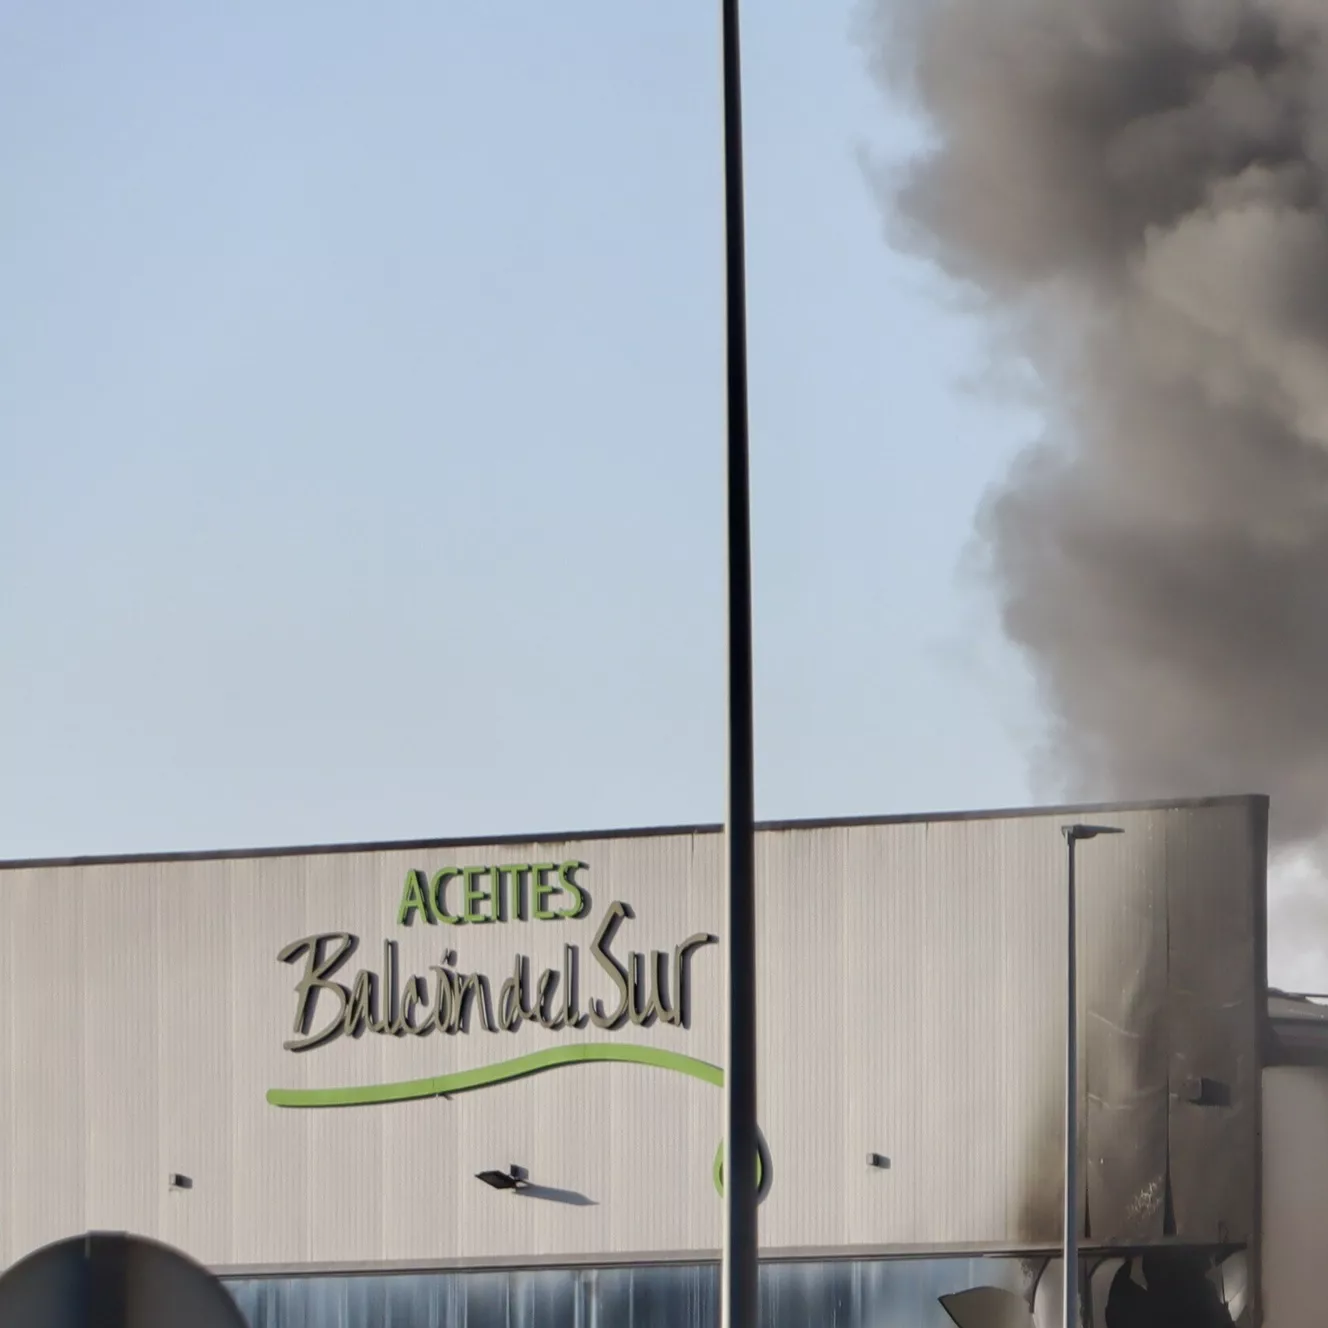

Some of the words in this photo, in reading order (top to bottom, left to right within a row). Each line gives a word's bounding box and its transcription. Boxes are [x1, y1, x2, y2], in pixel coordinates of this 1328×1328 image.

[398, 859, 588, 925] ACEITES
[277, 931, 497, 1052] Balcón
[499, 943, 587, 1031] del
[588, 900, 716, 1030] Sur
